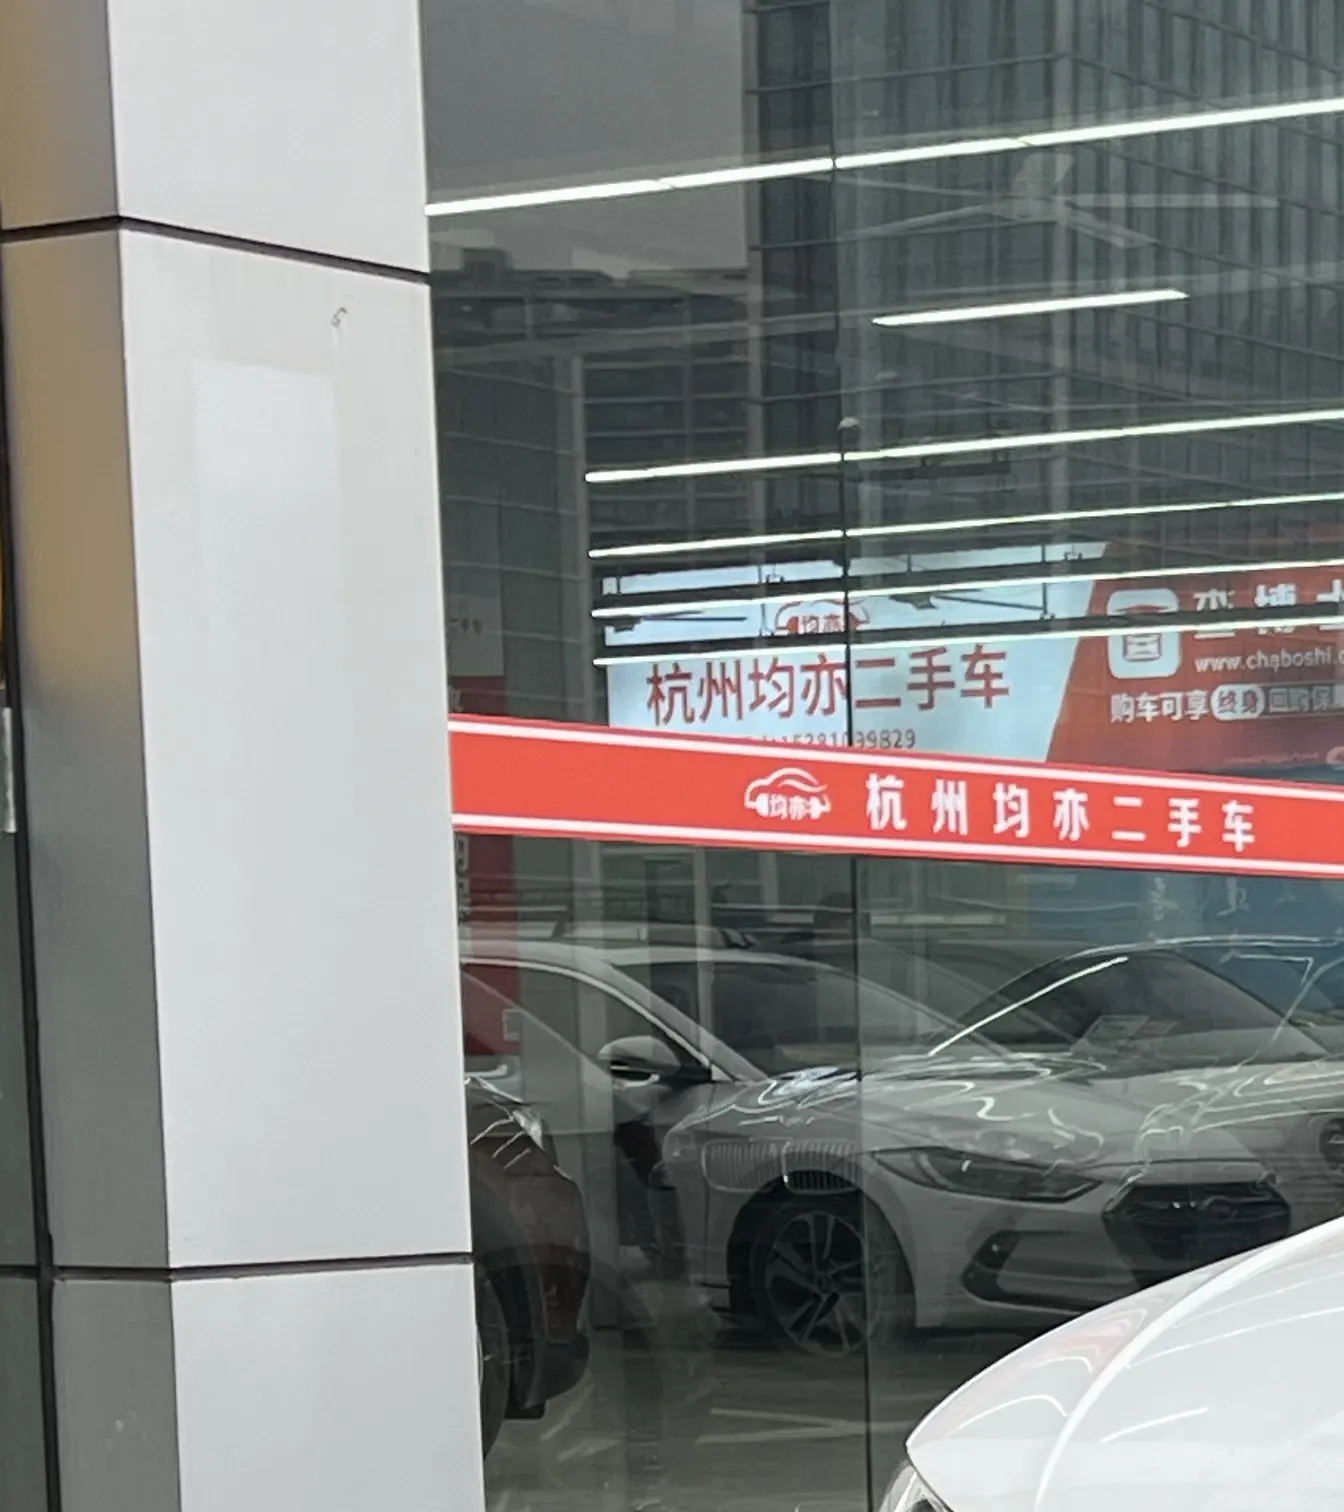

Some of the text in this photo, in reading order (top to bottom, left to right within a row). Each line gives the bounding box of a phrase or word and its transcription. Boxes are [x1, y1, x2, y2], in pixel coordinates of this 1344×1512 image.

[646, 643, 1010, 727] 杭州均亦二手车
[864, 773, 1256, 853] 杭州均亦二手车
